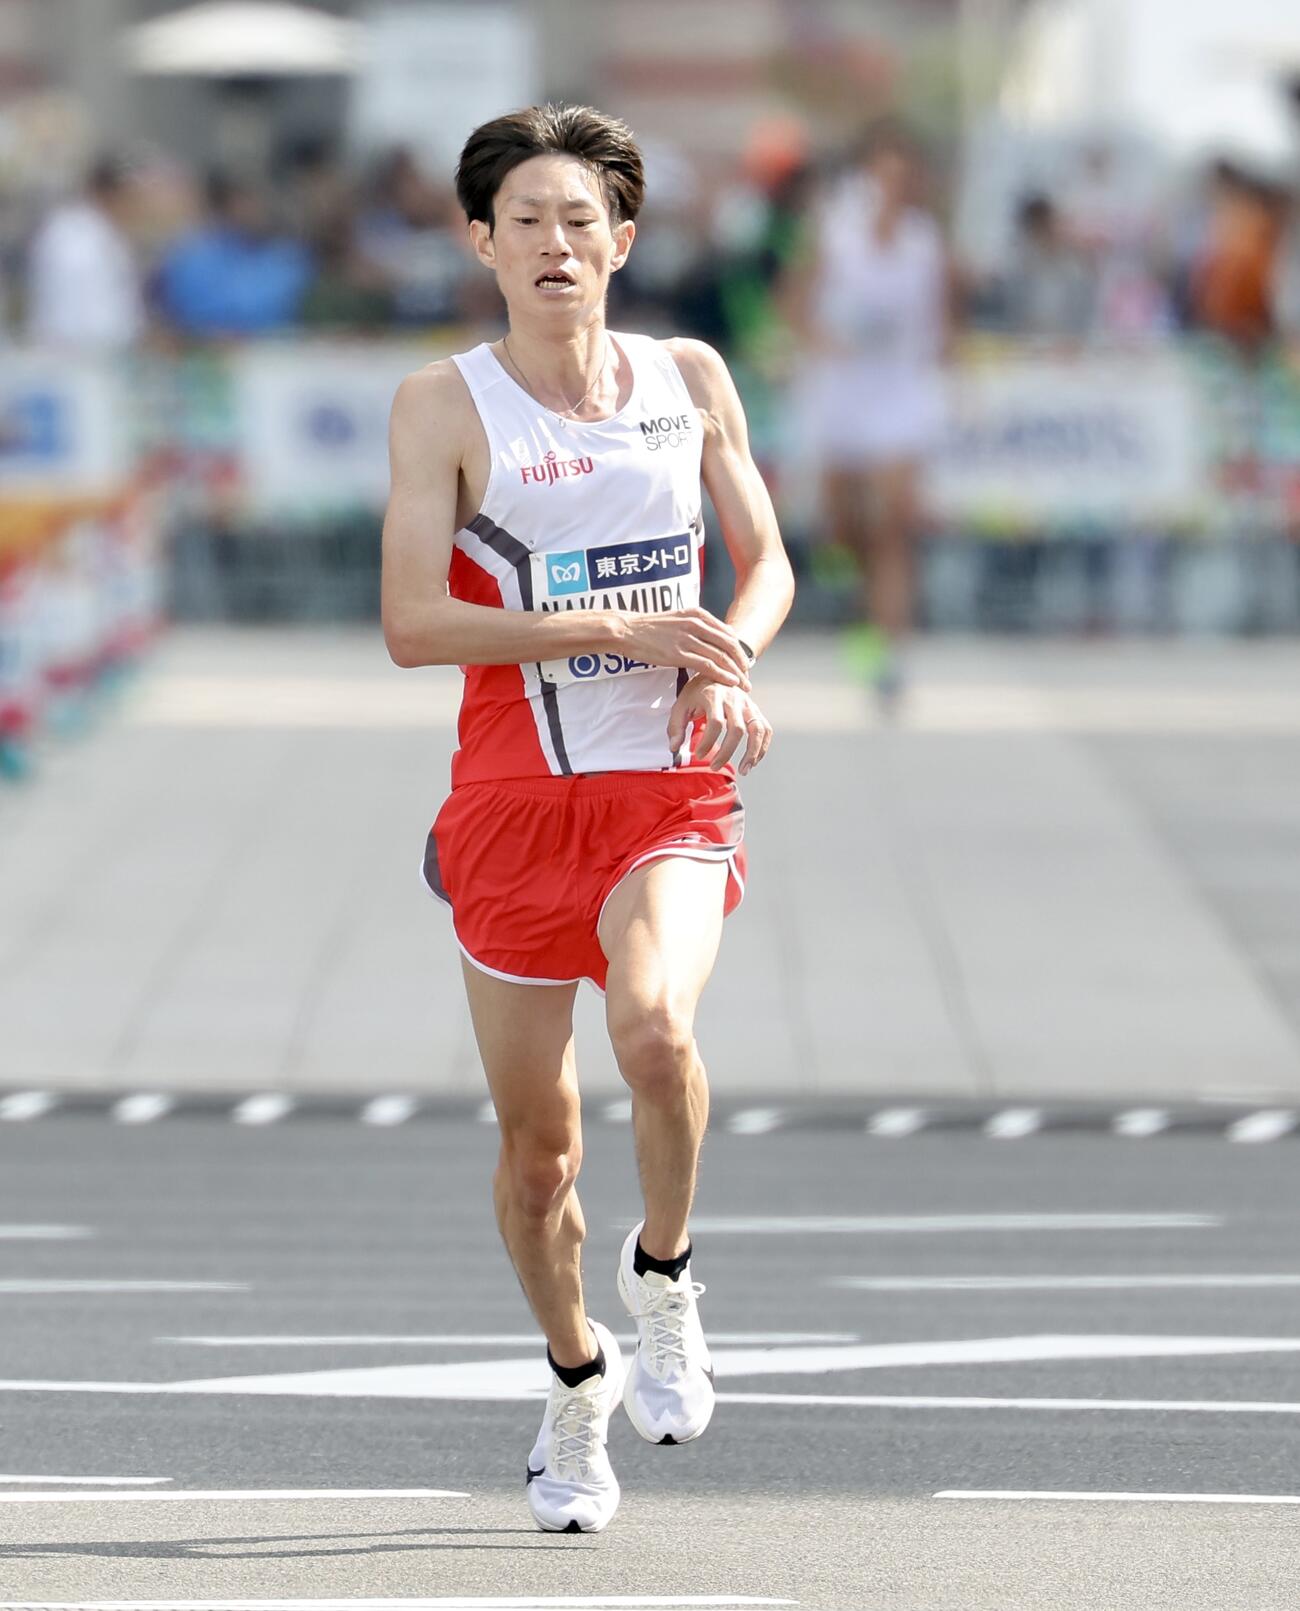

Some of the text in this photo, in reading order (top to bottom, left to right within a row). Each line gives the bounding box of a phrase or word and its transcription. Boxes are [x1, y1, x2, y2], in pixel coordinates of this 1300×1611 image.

[639, 414, 691, 436] MOVE
[520, 451, 594, 486] FUJITSU
[595, 545, 688, 579] 東京メトロ
